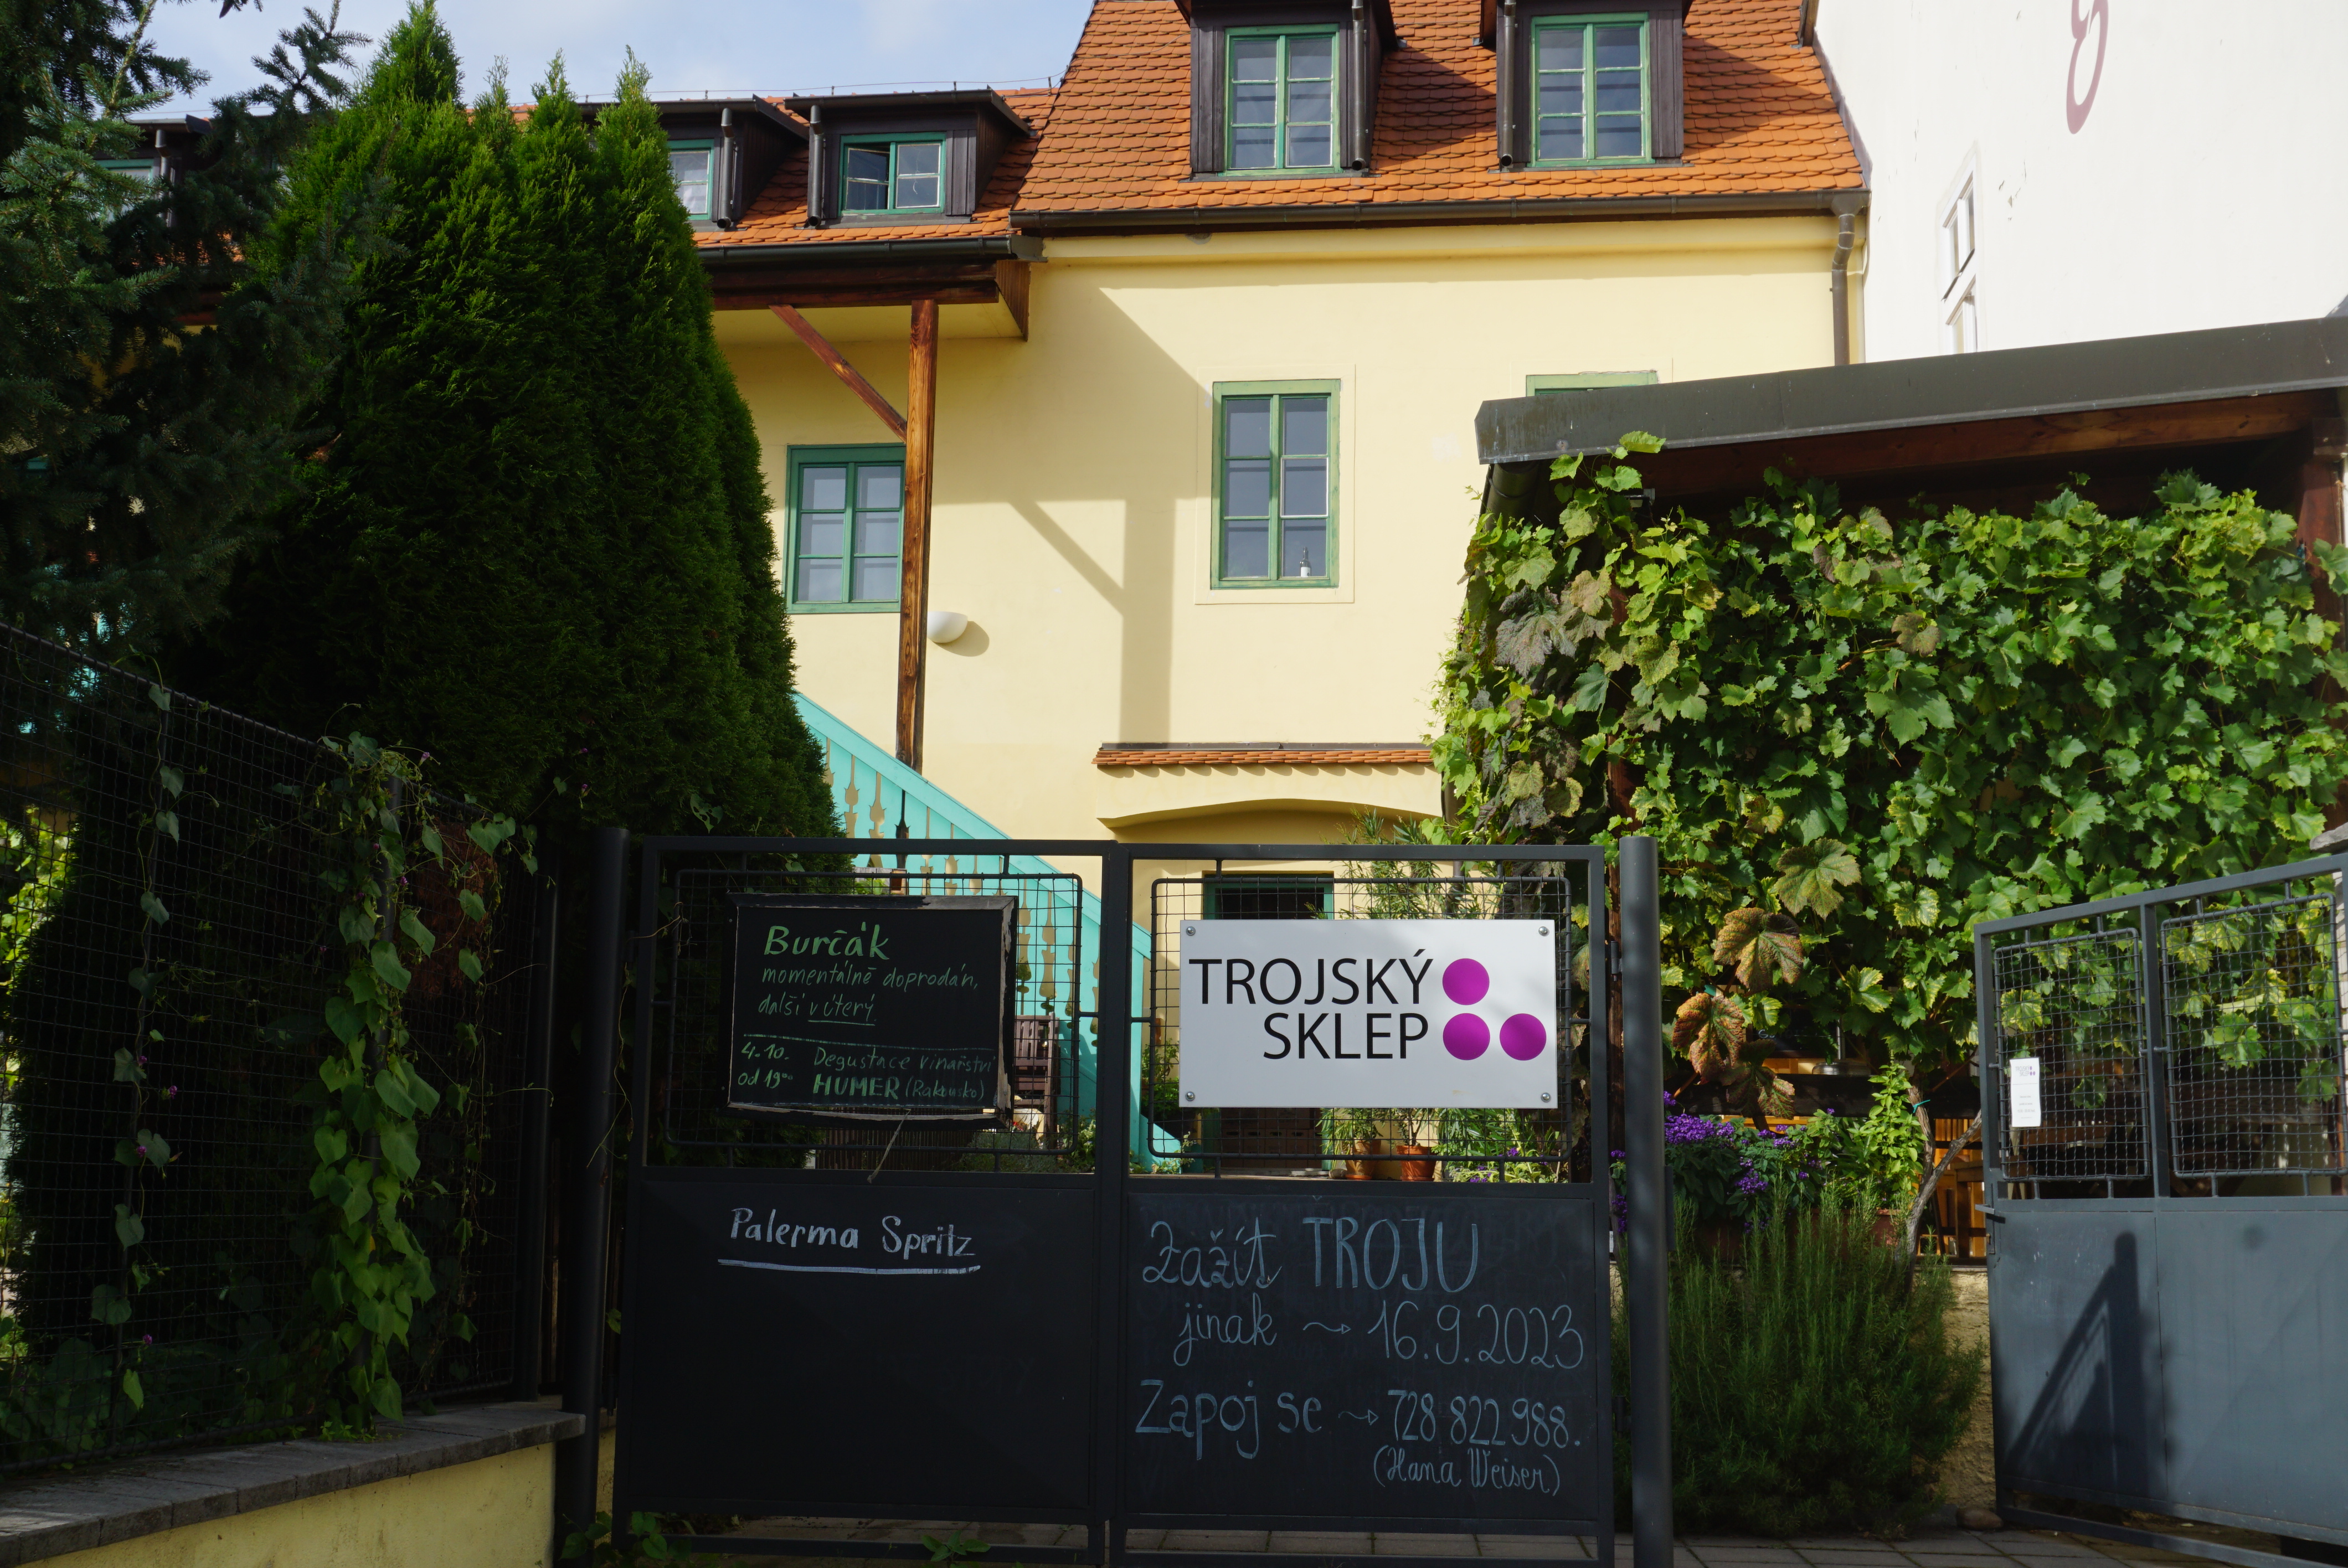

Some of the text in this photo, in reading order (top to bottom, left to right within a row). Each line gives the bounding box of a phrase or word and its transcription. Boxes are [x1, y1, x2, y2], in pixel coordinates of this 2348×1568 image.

[764, 922, 889, 960] Burčák
[1189, 950, 1433, 1004] TROJSKÝ
[810, 1002, 818, 1015] v
[814, 1046, 910, 1071] Degustace
[1264, 1013, 1428, 1059] SKLEP
[738, 1069, 760, 1085] od
[813, 1074, 899, 1100] HUMER
[731, 1208, 975, 1260] Palerma Spritz
[1302, 1217, 1478, 1292] TROJU
[1173, 1292, 1276, 1366] jinak
[1368, 1300, 1583, 1369] 16.9.2023
[1135, 1379, 1322, 1460] Zapoj se
[1388, 1390, 1435, 1441] 728
[1450, 1396, 1506, 1445] 822
